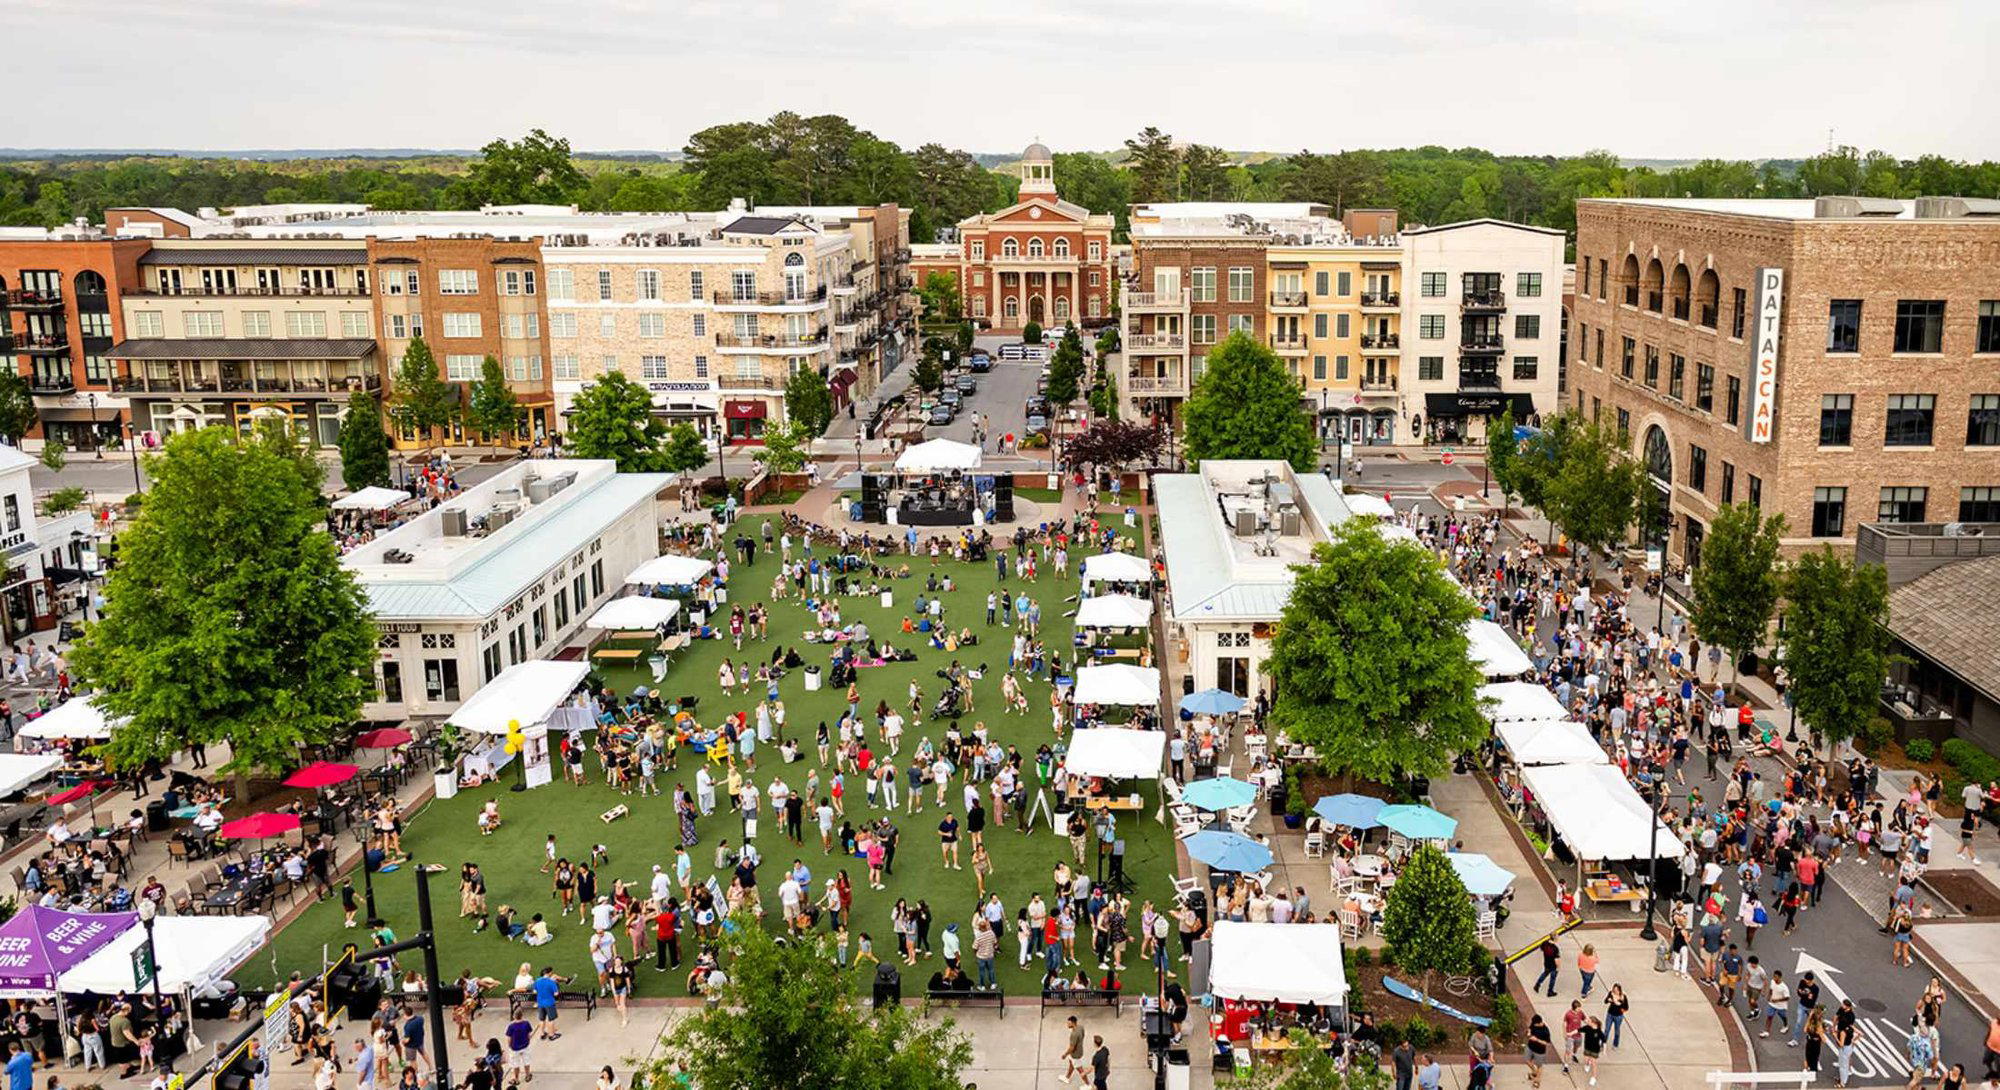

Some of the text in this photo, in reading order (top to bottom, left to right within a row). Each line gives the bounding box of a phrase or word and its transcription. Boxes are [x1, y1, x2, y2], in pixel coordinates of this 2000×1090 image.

[1756, 274, 1780, 438] DATASCAN
[0, 937, 31, 951] EER
[46, 917, 83, 943] BEER
[58, 921, 107, 954] & WINE
